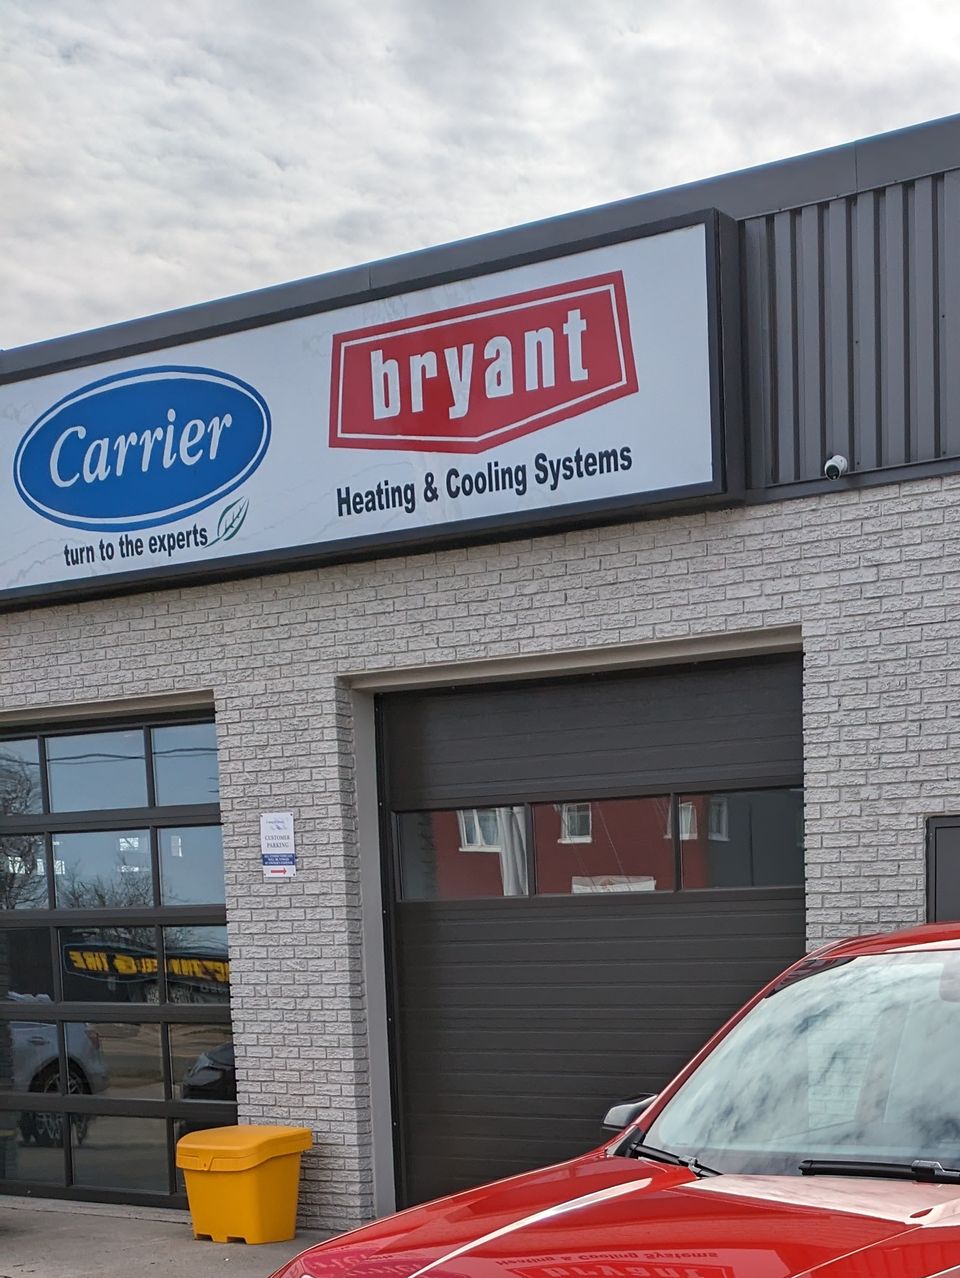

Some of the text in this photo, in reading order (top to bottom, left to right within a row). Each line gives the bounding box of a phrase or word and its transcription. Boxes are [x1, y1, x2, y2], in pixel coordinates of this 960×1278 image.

[370, 308, 588, 421] bryant
[50, 408, 233, 488] Carrier
[336, 445, 633, 517] Heating & Cooling Systems
[63, 523, 209, 567] turn to the experts
